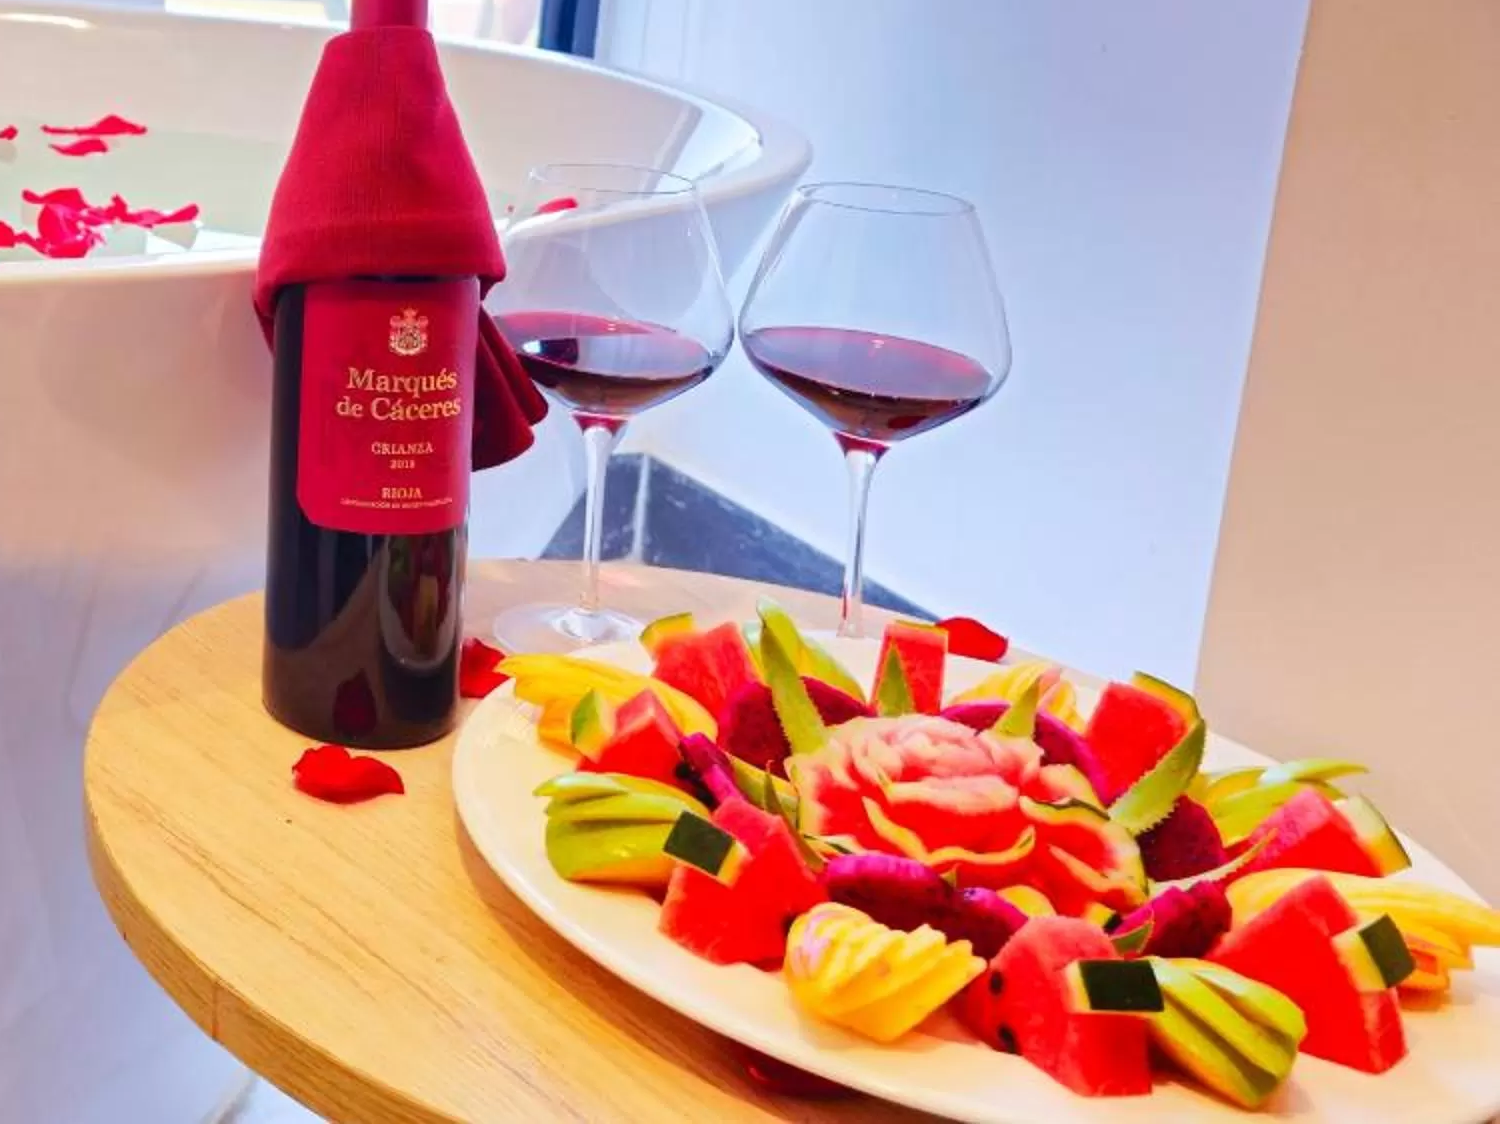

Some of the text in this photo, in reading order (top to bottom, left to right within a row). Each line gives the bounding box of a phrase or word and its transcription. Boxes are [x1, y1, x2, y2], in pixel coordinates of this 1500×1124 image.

[346, 367, 457, 398] Marqués
[336, 396, 461, 421] de Cáceres
[371, 440, 433, 455] CRIANZA
[381, 487, 423, 499] RIOJA
